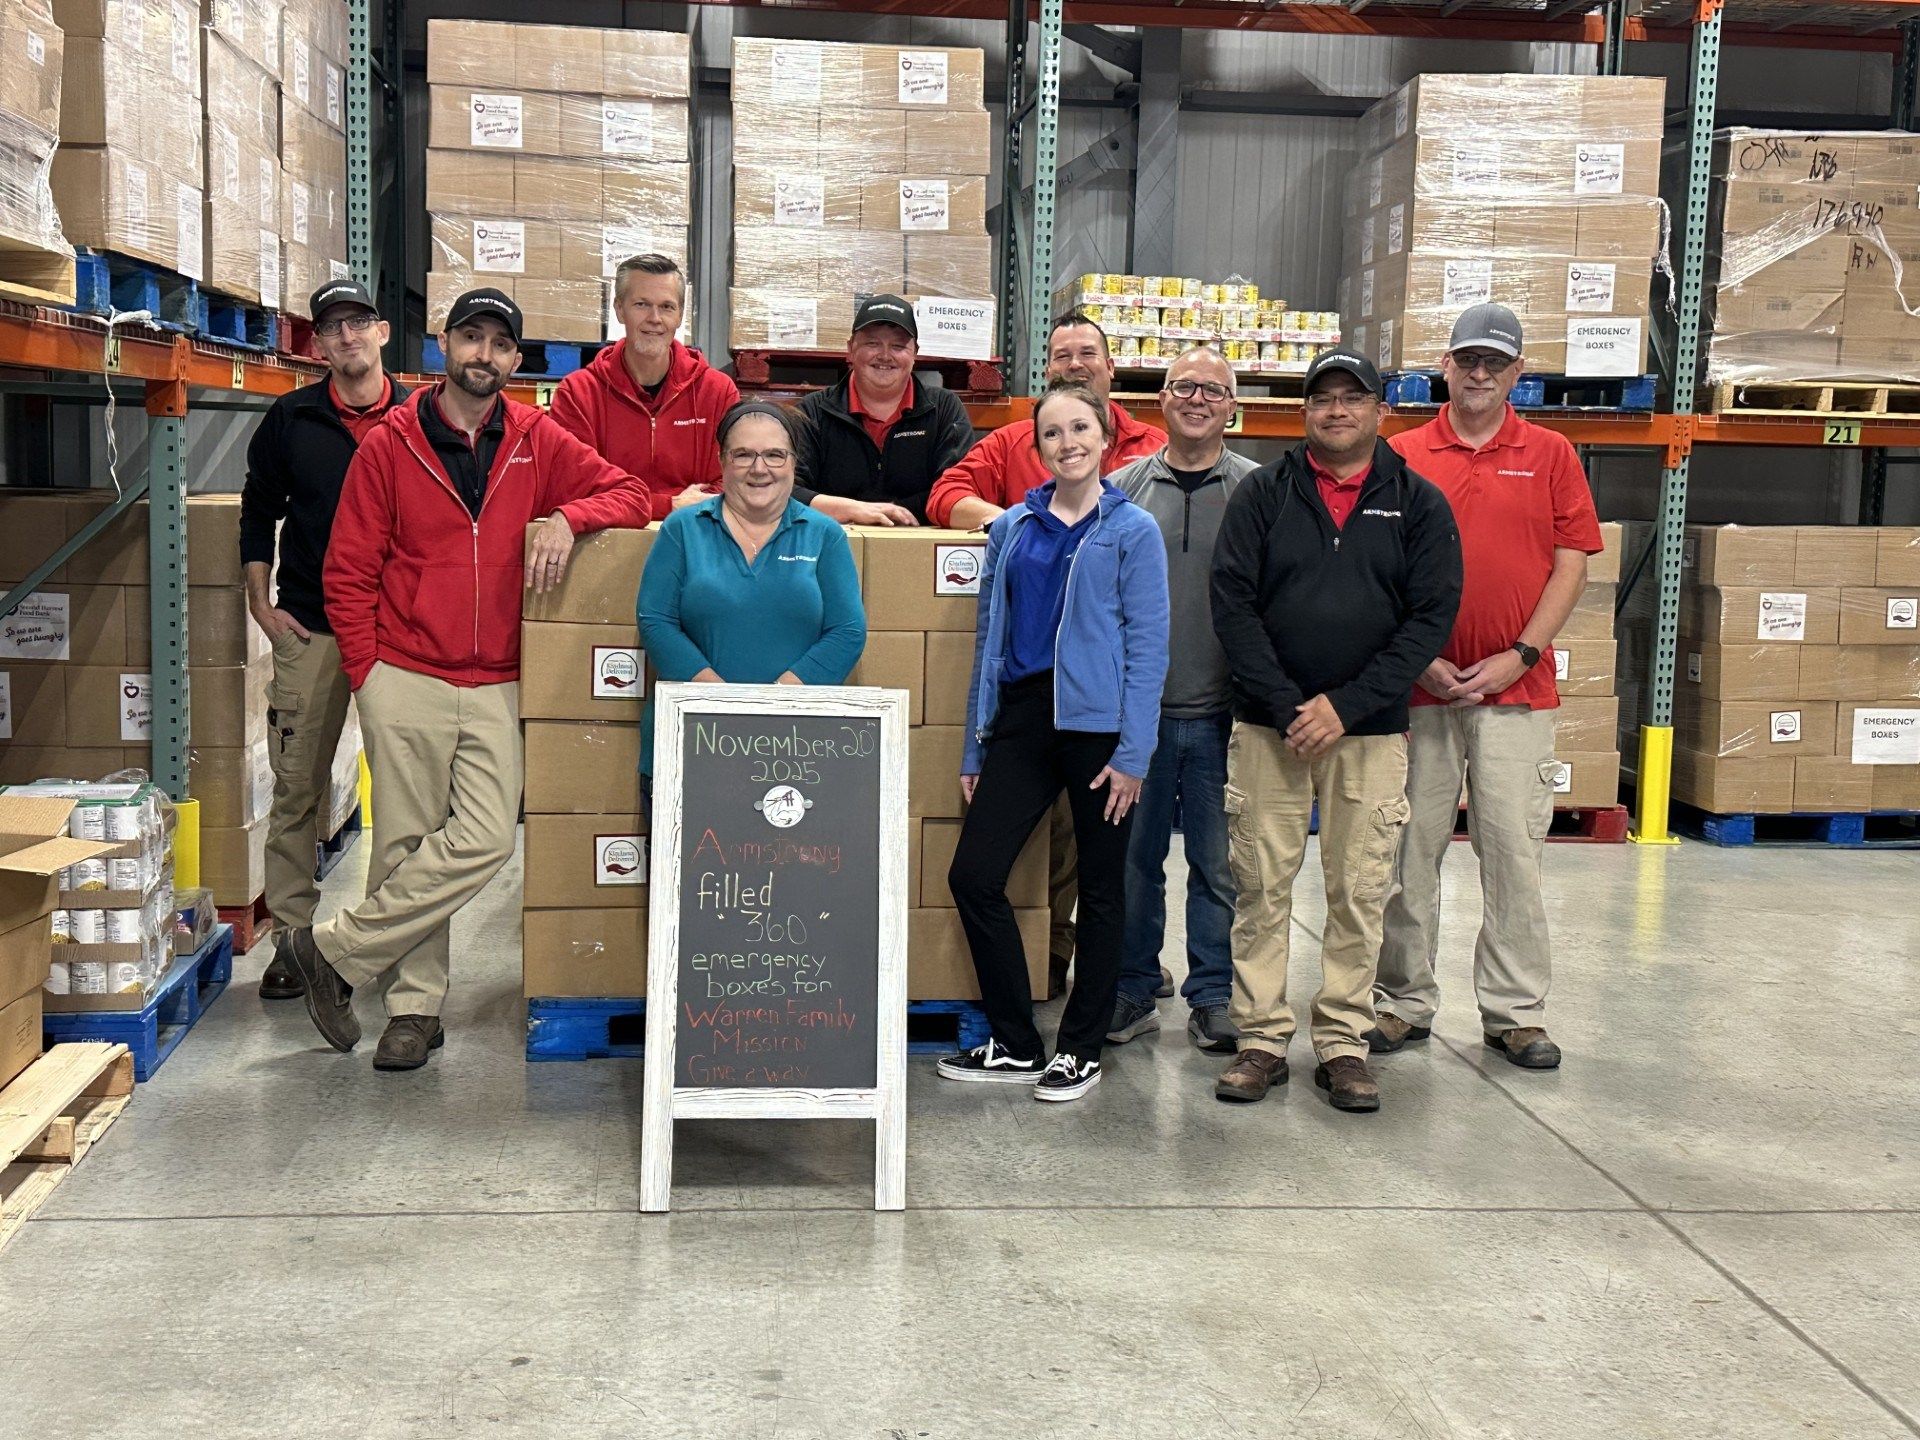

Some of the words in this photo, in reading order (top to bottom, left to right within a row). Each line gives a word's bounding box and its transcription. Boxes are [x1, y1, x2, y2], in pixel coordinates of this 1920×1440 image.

[929, 307, 984, 318] EMERGENCY
[938, 322, 967, 331] BOXES
[1577, 328, 1631, 336] EMERGENCY
[1828, 426, 1854, 443] 21
[696, 722, 839, 758] November
[1872, 731, 1899, 739] BOXES
[750, 760, 821, 784] 2025
[697, 872, 773, 909] filled
[692, 953, 826, 981] emergency
[708, 973, 785, 998] boxes
[793, 971, 832, 995] for
[685, 1001, 780, 1028] Warren
[787, 999, 855, 1034] Family
[714, 1029, 807, 1054] Mission
[689, 1055, 735, 1084] Give
